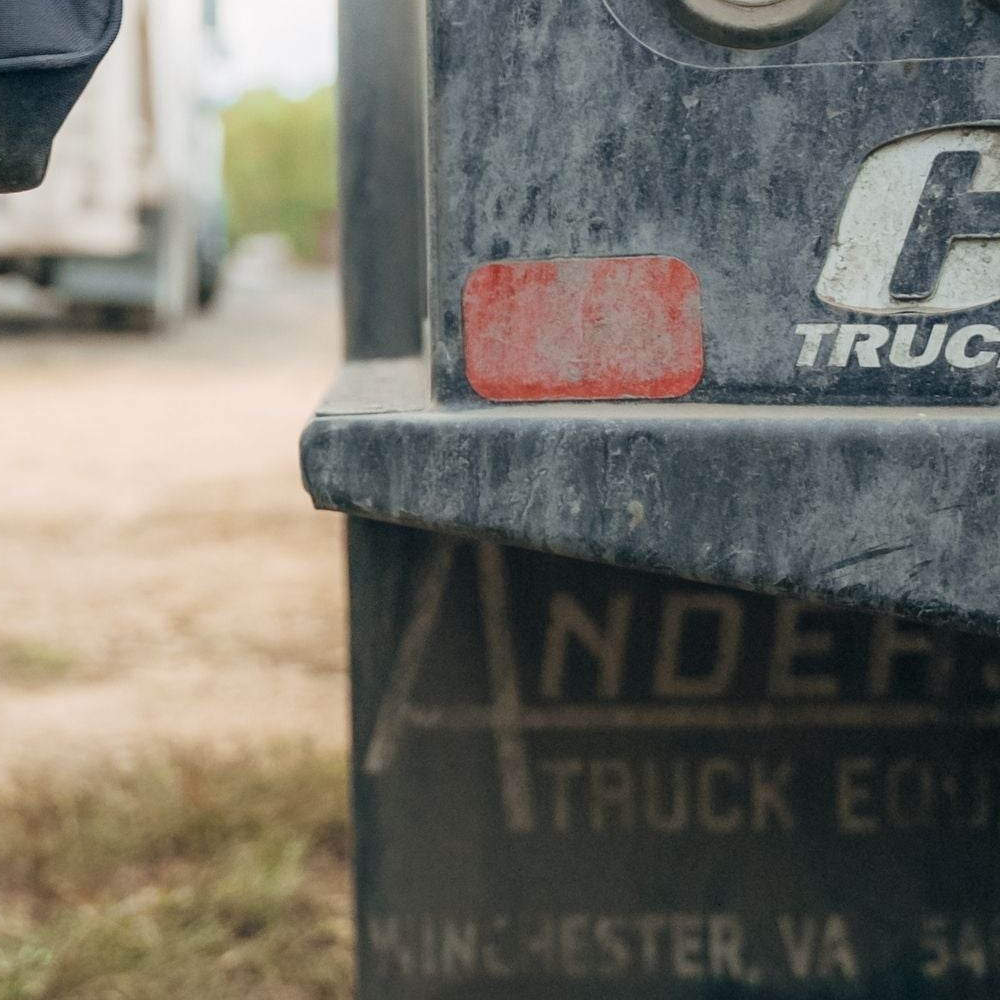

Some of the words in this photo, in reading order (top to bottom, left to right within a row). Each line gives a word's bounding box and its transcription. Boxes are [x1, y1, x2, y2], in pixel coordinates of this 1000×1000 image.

[795, 323, 1000, 368] TRUC
[363, 538, 1000, 834] ANDER
[538, 757, 796, 832] TRUCK
[776, 913, 858, 979] VA
